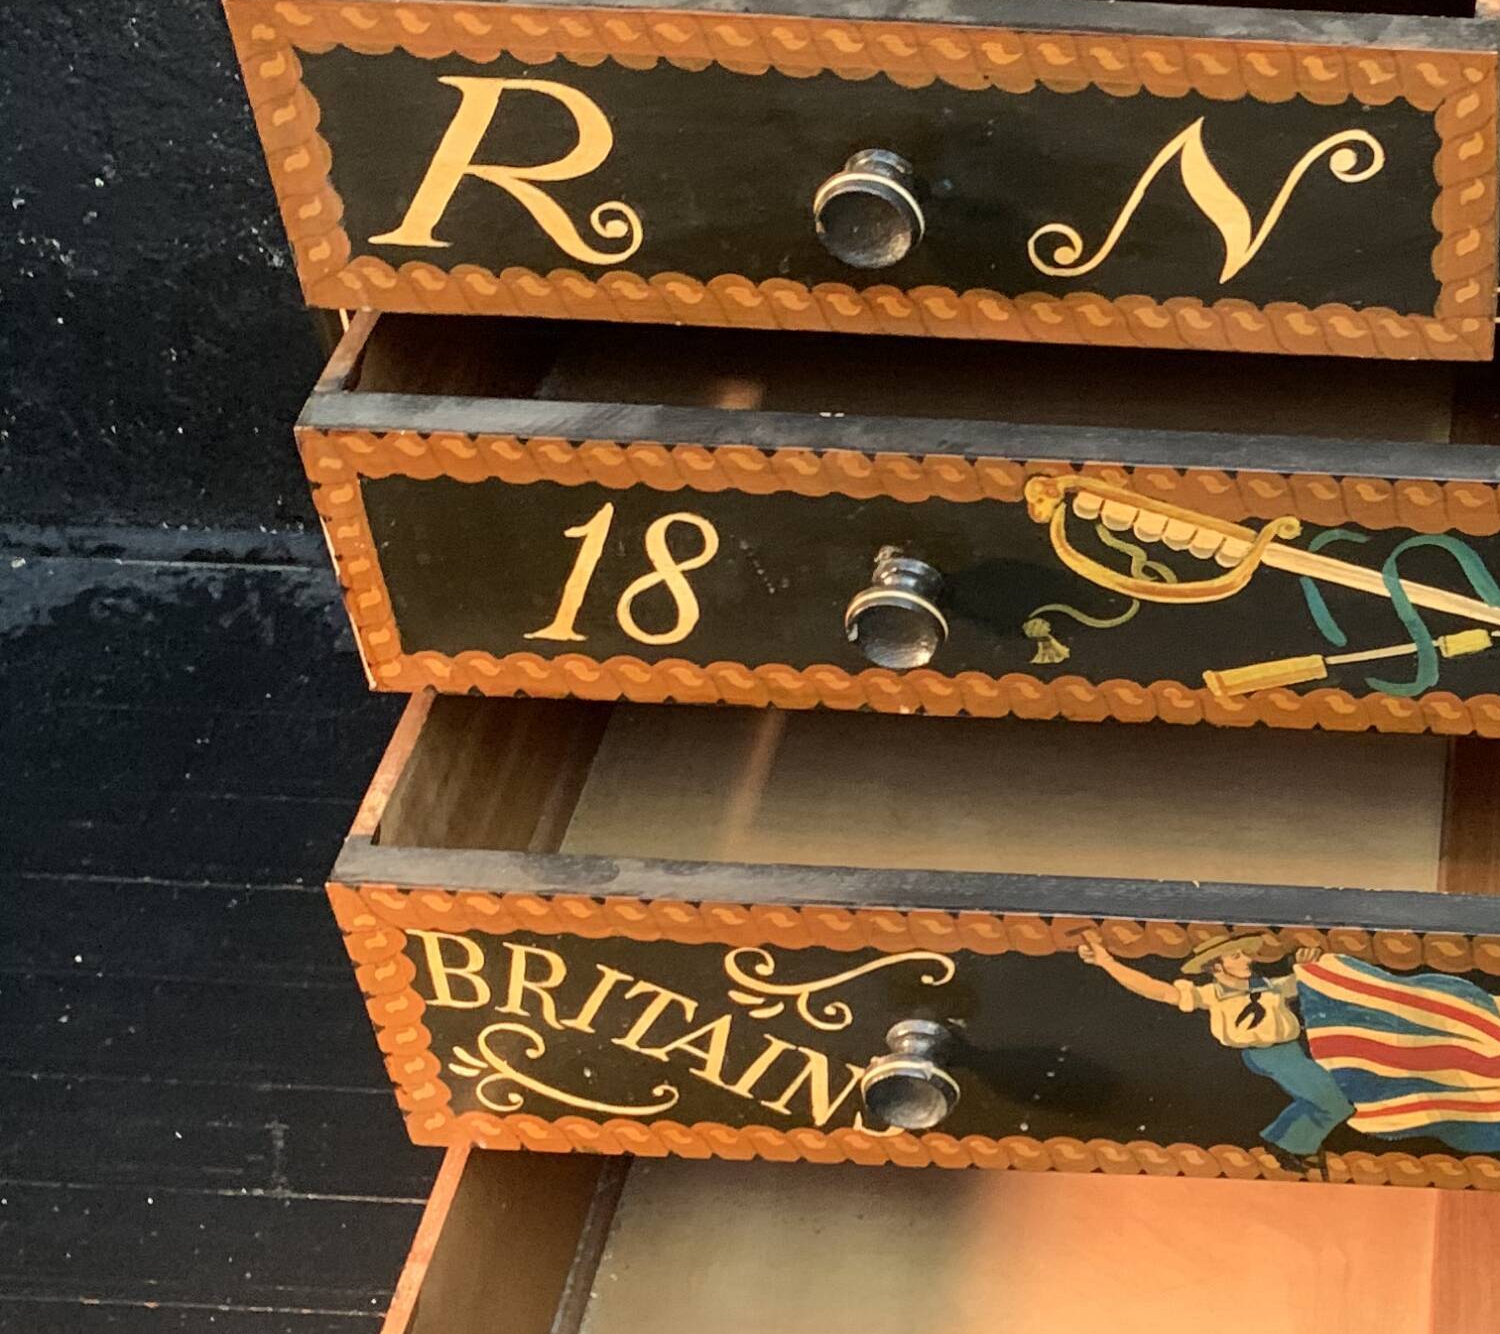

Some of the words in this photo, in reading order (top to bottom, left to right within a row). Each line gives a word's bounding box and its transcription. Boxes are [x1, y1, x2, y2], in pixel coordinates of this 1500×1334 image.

[369, 75, 643, 266] R
[1027, 117, 1385, 284] N
[523, 502, 721, 646] 18
